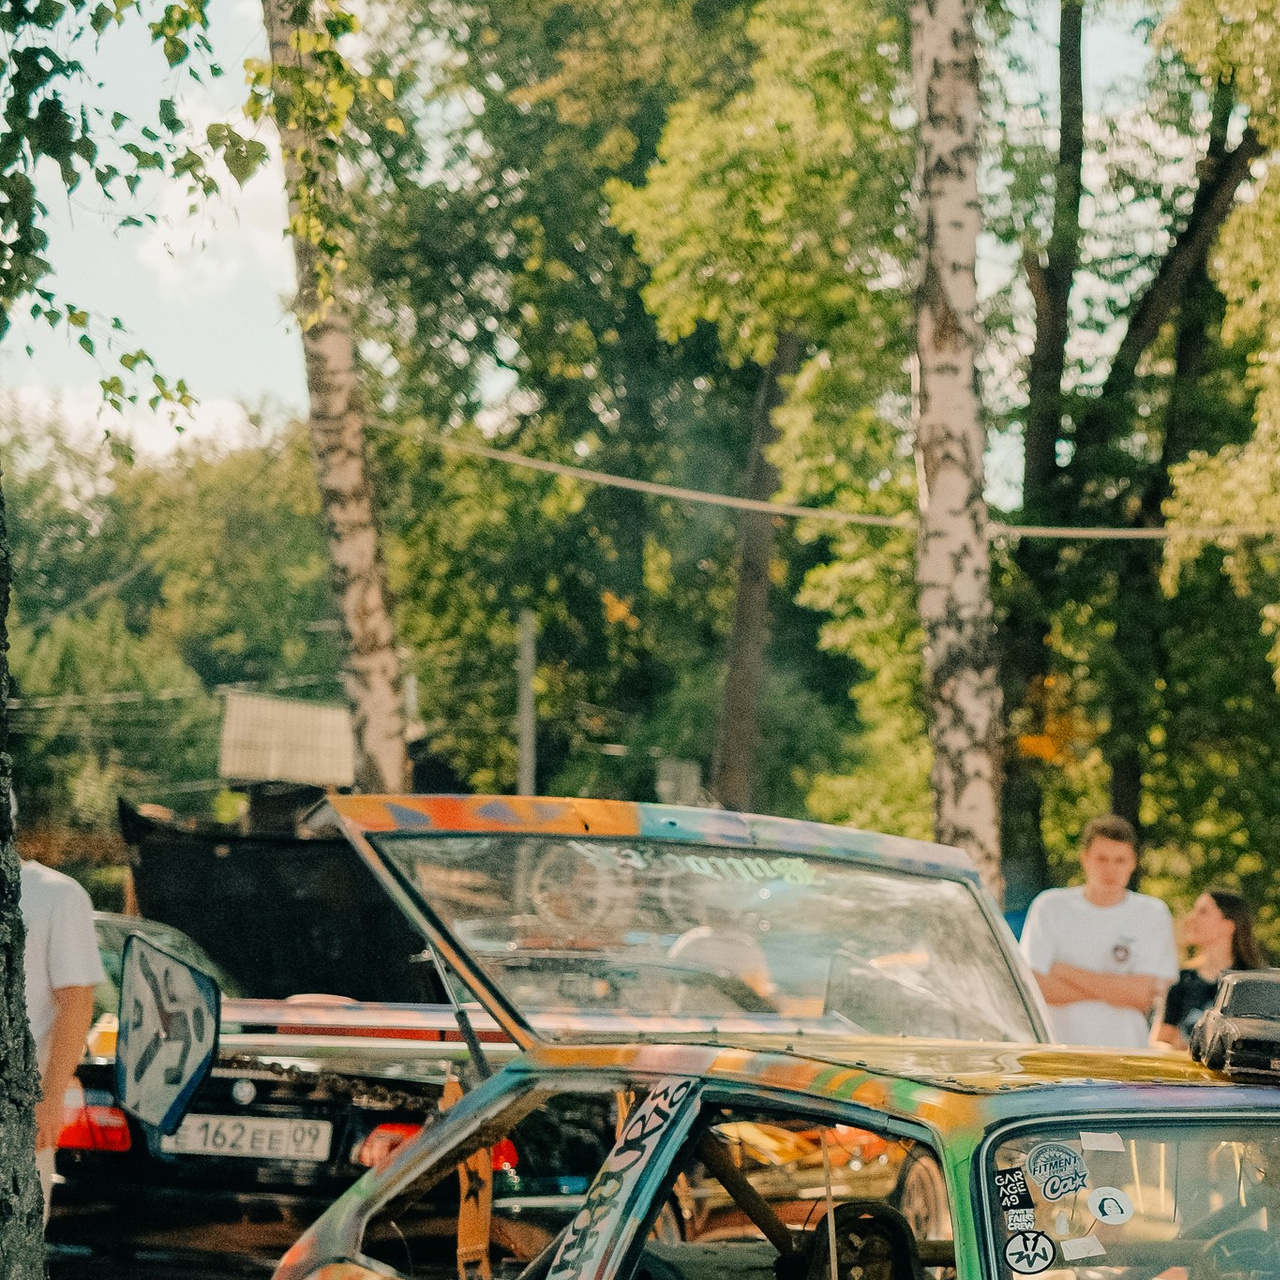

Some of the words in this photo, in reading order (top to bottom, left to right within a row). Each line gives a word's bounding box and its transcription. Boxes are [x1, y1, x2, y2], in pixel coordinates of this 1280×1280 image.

[1032, 1155, 1079, 1176] FITMENT
[994, 1171, 1024, 1186] GAR
[999, 1181, 1027, 1198] AGE
[1002, 1195, 1020, 1207] 49
[1007, 1222, 1034, 1231] CREW
